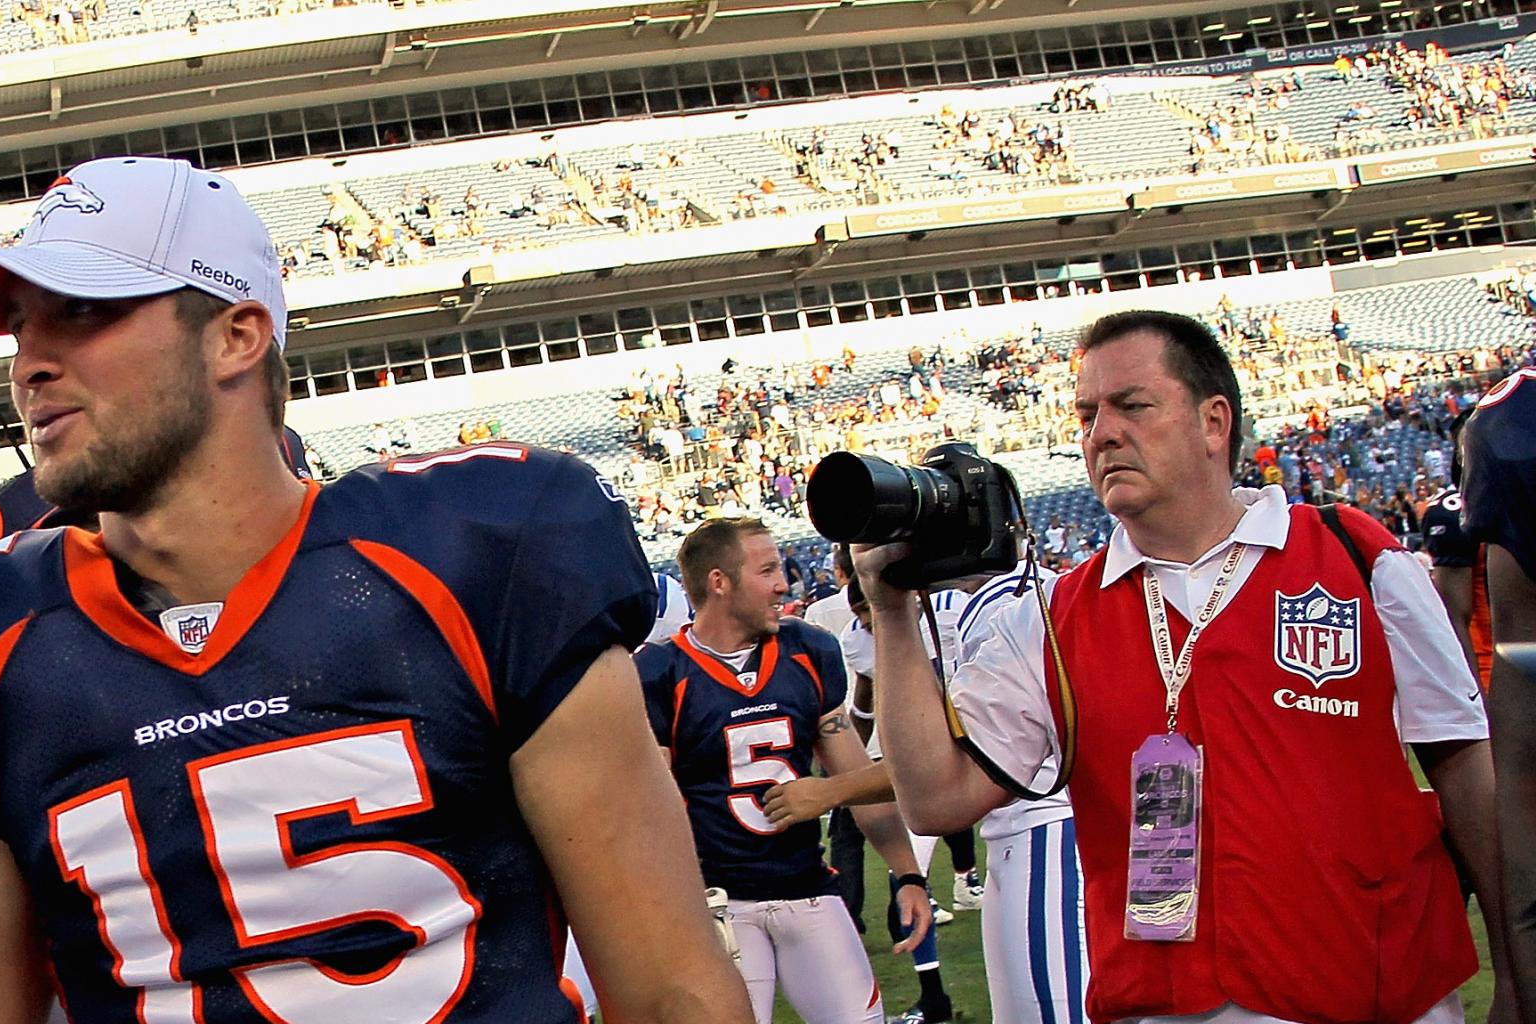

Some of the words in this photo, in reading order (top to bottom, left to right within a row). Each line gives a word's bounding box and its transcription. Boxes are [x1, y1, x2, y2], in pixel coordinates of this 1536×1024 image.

[1209, 63, 1224, 72] TO
[1289, 51, 1304, 61] OR
[1305, 48, 1332, 58] CALL
[191, 259, 252, 298] Reebok
[1149, 579, 1161, 609] Canon
[1199, 590, 1221, 623] Canon
[182, 628, 210, 643] NFL
[1158, 628, 1170, 664] Canon
[1285, 625, 1351, 670] NFL
[1175, 641, 1196, 678] Canon
[730, 703, 778, 718] BRONCOS
[1273, 688, 1359, 717] Canon
[134, 696, 291, 745] BRONCOS
[723, 716, 801, 836] 5
